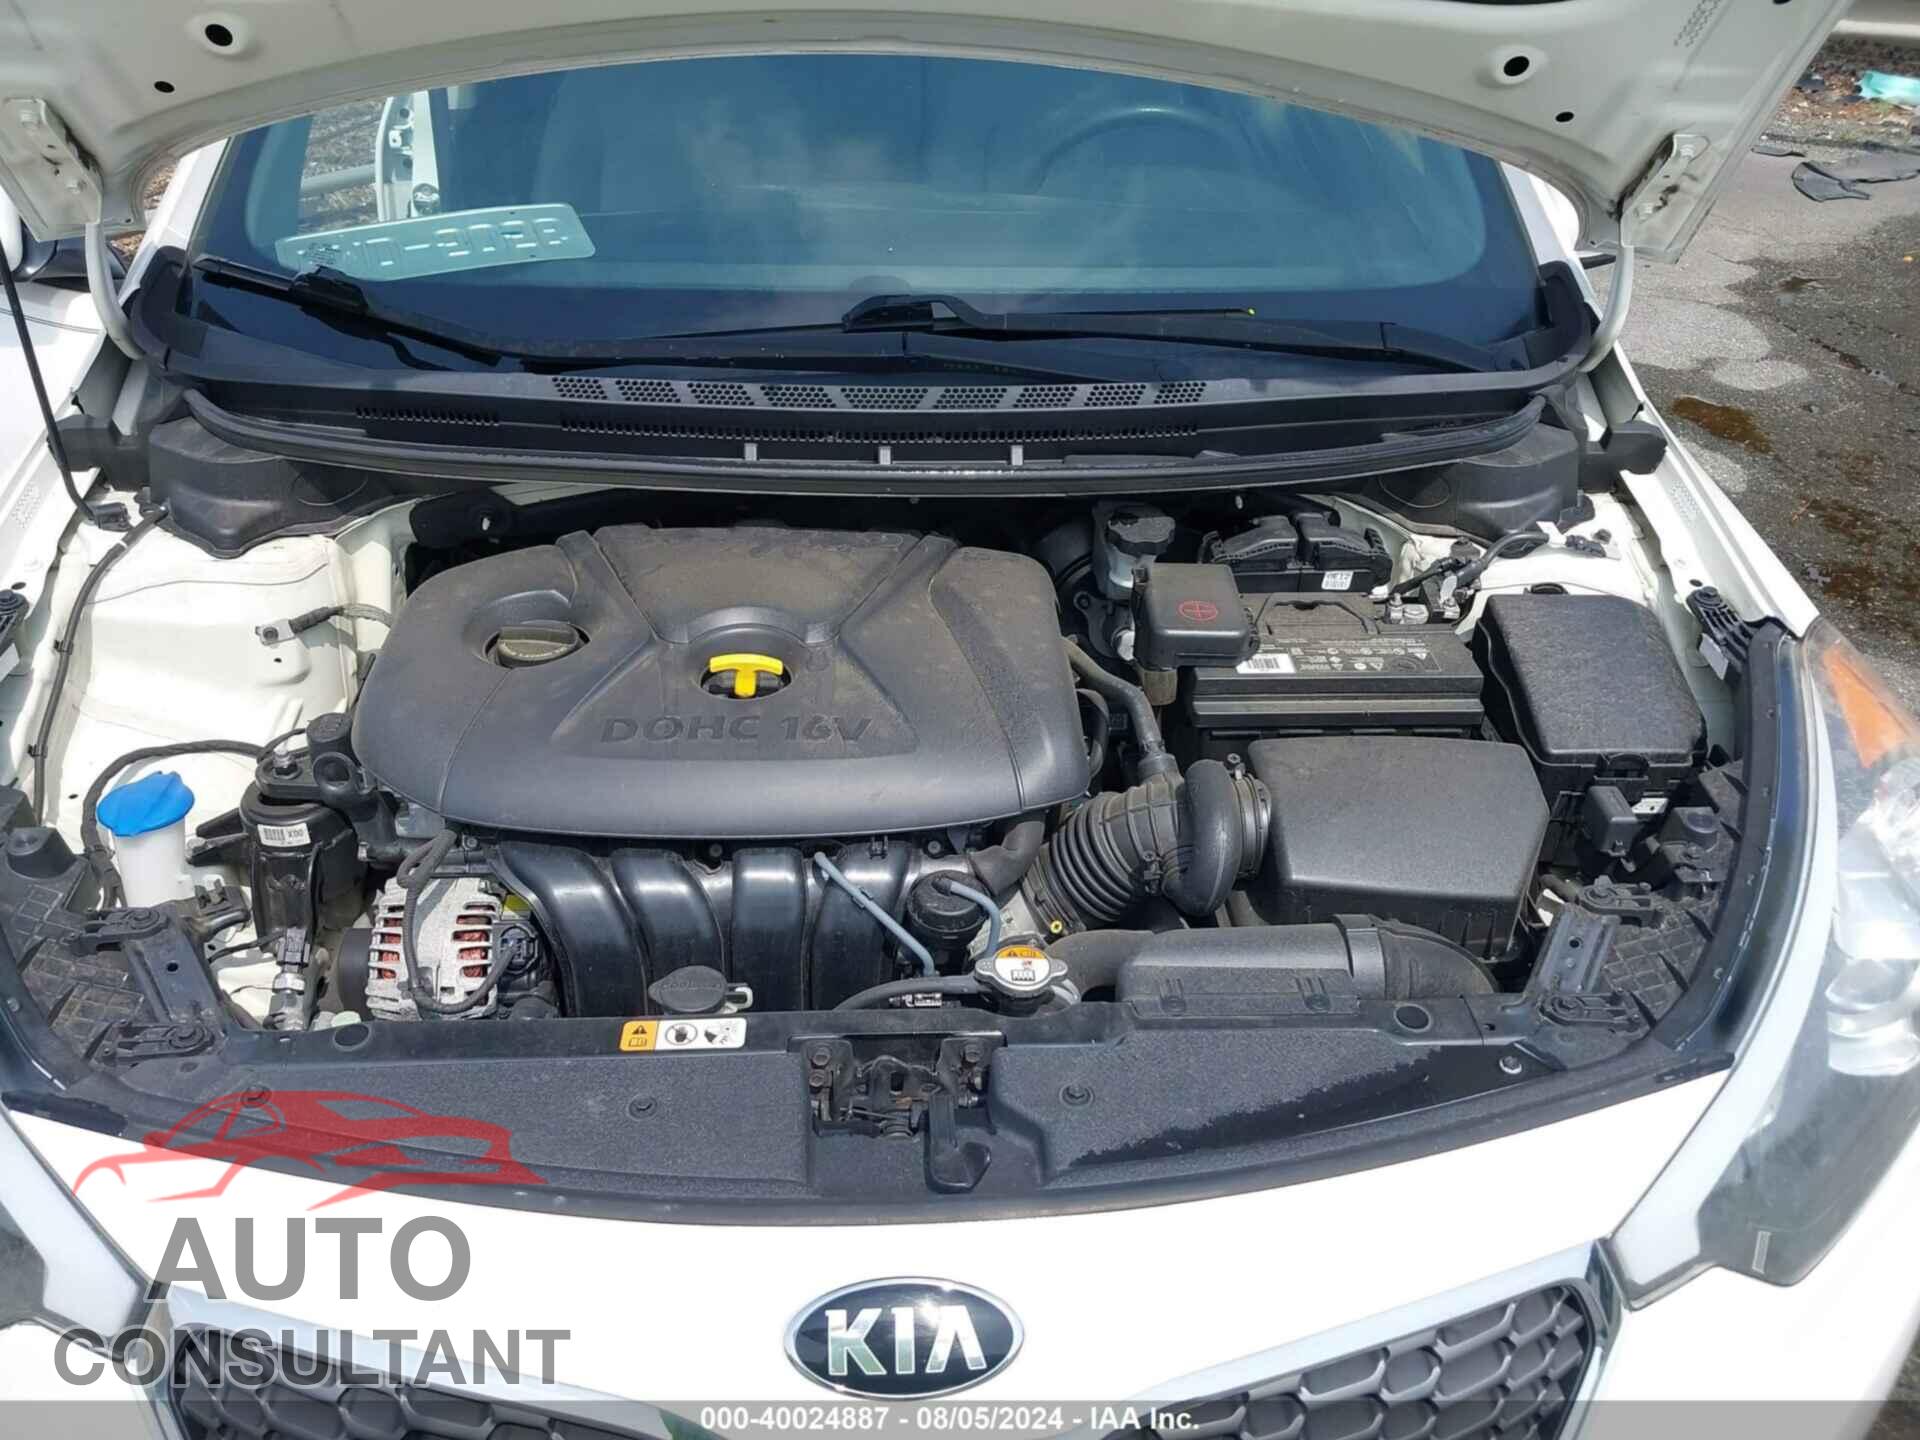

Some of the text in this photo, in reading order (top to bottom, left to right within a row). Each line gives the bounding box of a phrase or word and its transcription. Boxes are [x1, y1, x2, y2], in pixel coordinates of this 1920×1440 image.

[602, 714, 873, 742] DOHC 16V
[825, 1305, 987, 1376] KIA
